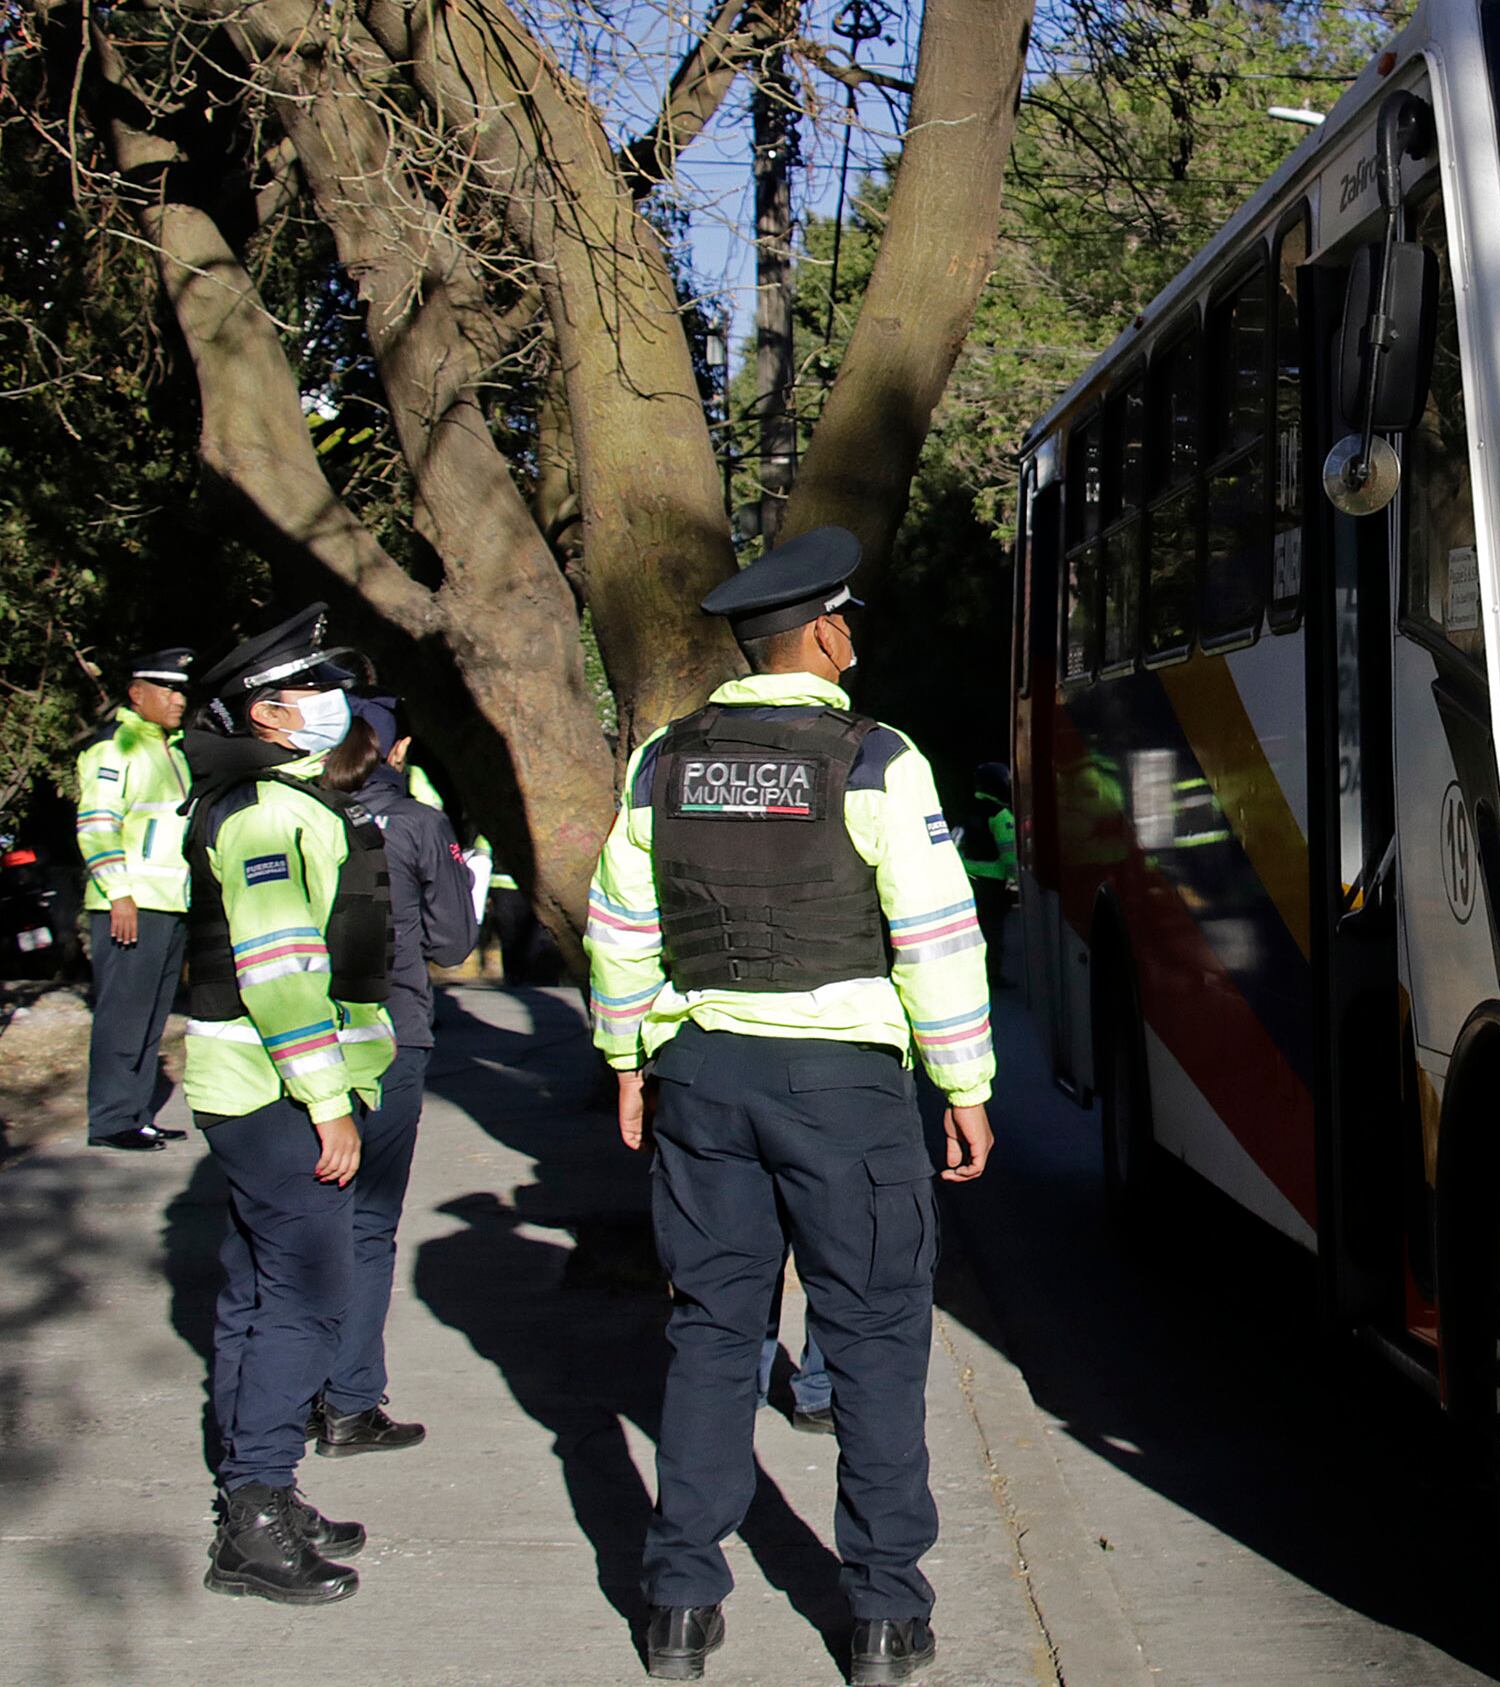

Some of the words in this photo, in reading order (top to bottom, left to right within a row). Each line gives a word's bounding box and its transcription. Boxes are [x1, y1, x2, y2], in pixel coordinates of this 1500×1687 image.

[682, 762, 810, 788] POLICIA
[682, 786, 810, 807] MUNICIPAL
[1446, 798, 1469, 907] 19
